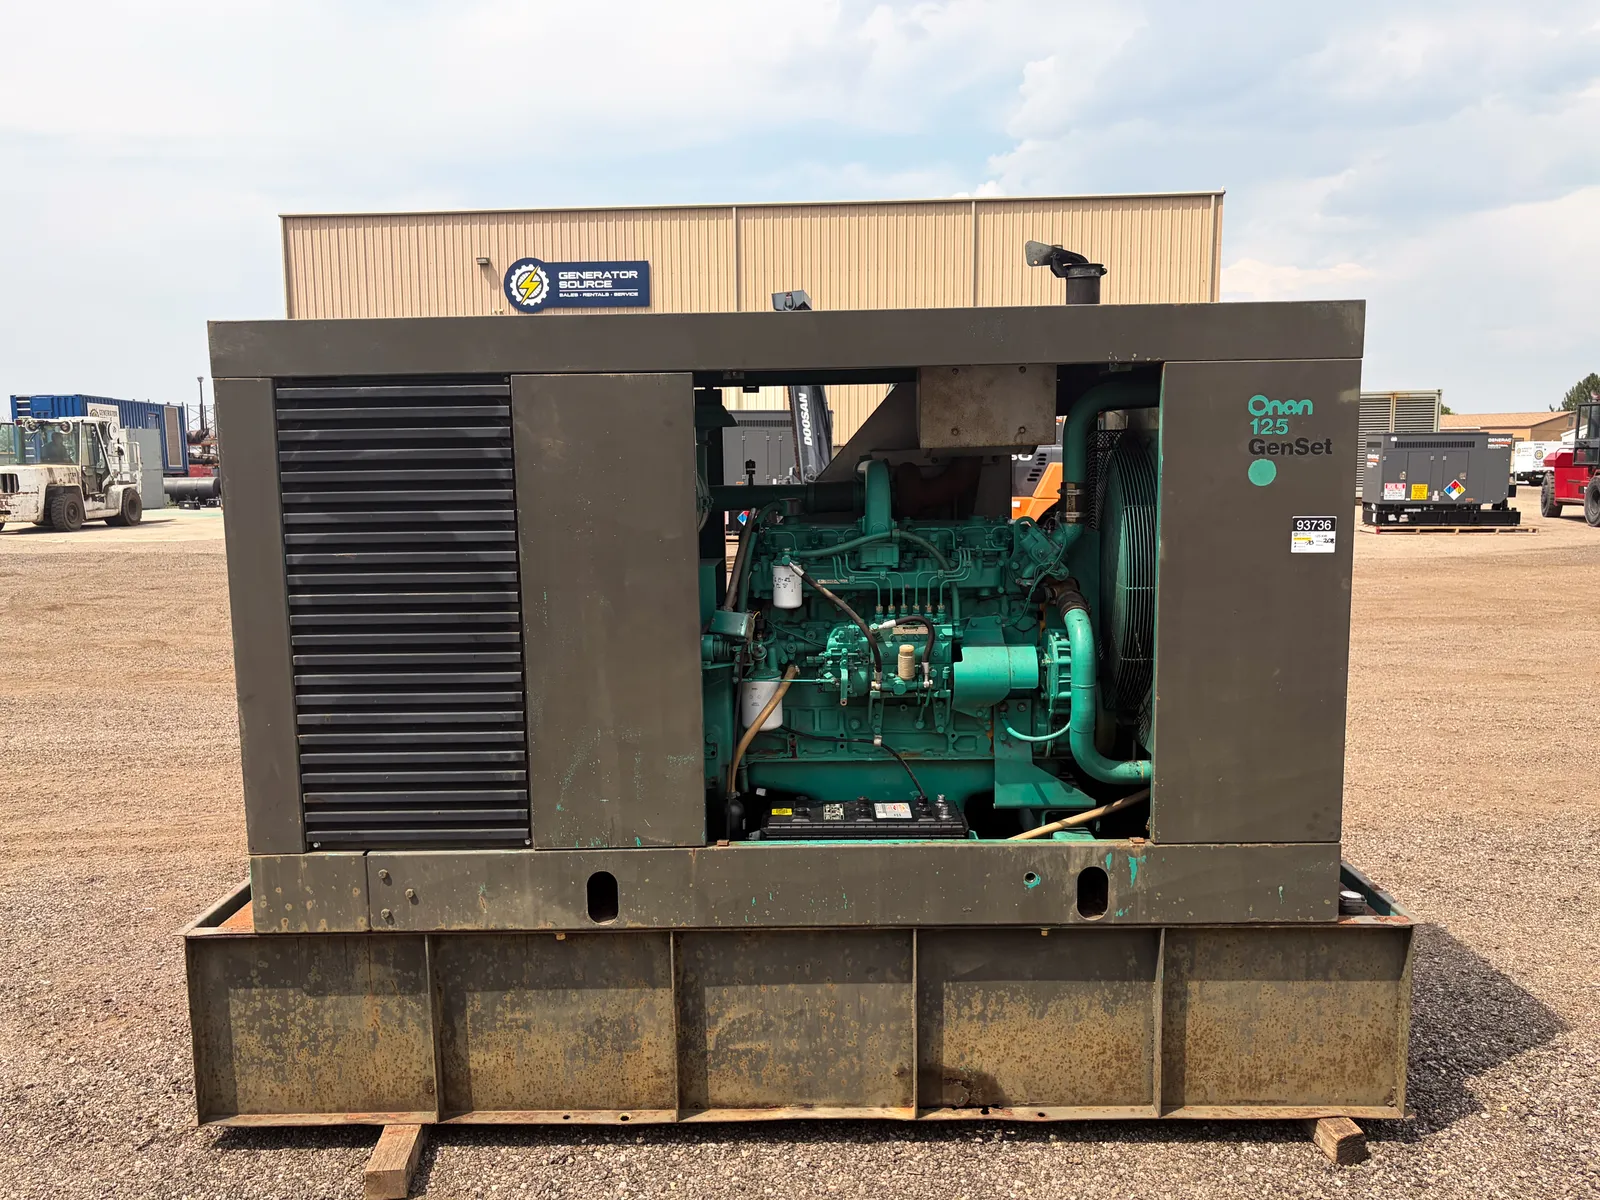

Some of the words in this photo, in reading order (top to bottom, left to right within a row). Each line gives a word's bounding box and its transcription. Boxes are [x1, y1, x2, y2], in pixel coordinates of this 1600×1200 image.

[558, 270, 638, 279] GENERATOR
[559, 280, 612, 289] SOURCE
[1247, 394, 1314, 417] Onan
[798, 393, 812, 446] DOOSAN
[1249, 418, 1289, 435] 125
[1248, 437, 1333, 456] GenSet
[1296, 519, 1332, 531] 93736
